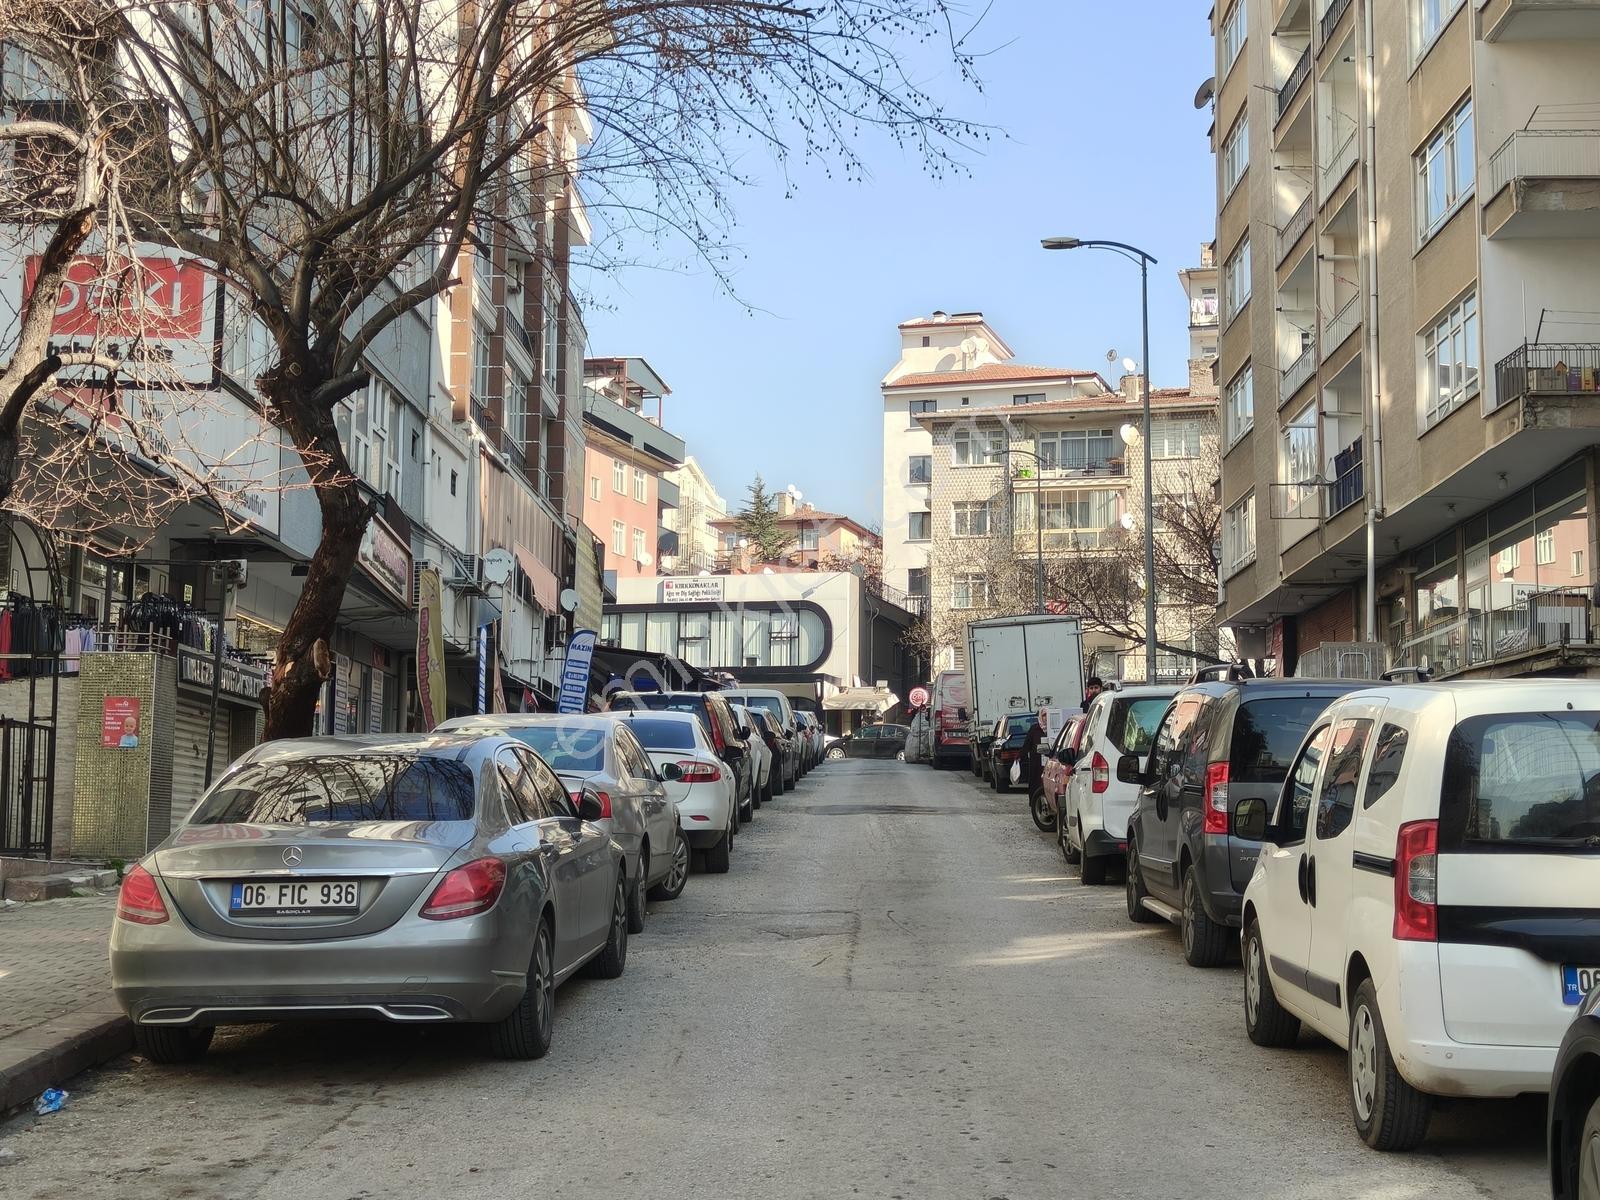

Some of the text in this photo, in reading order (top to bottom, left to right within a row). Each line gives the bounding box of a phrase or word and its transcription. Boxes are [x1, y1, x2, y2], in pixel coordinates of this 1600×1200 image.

[243, 885, 265, 905] 06
[278, 884, 308, 905] FIC
[320, 884, 355, 905] 936
[1567, 983, 1578, 991] TR
